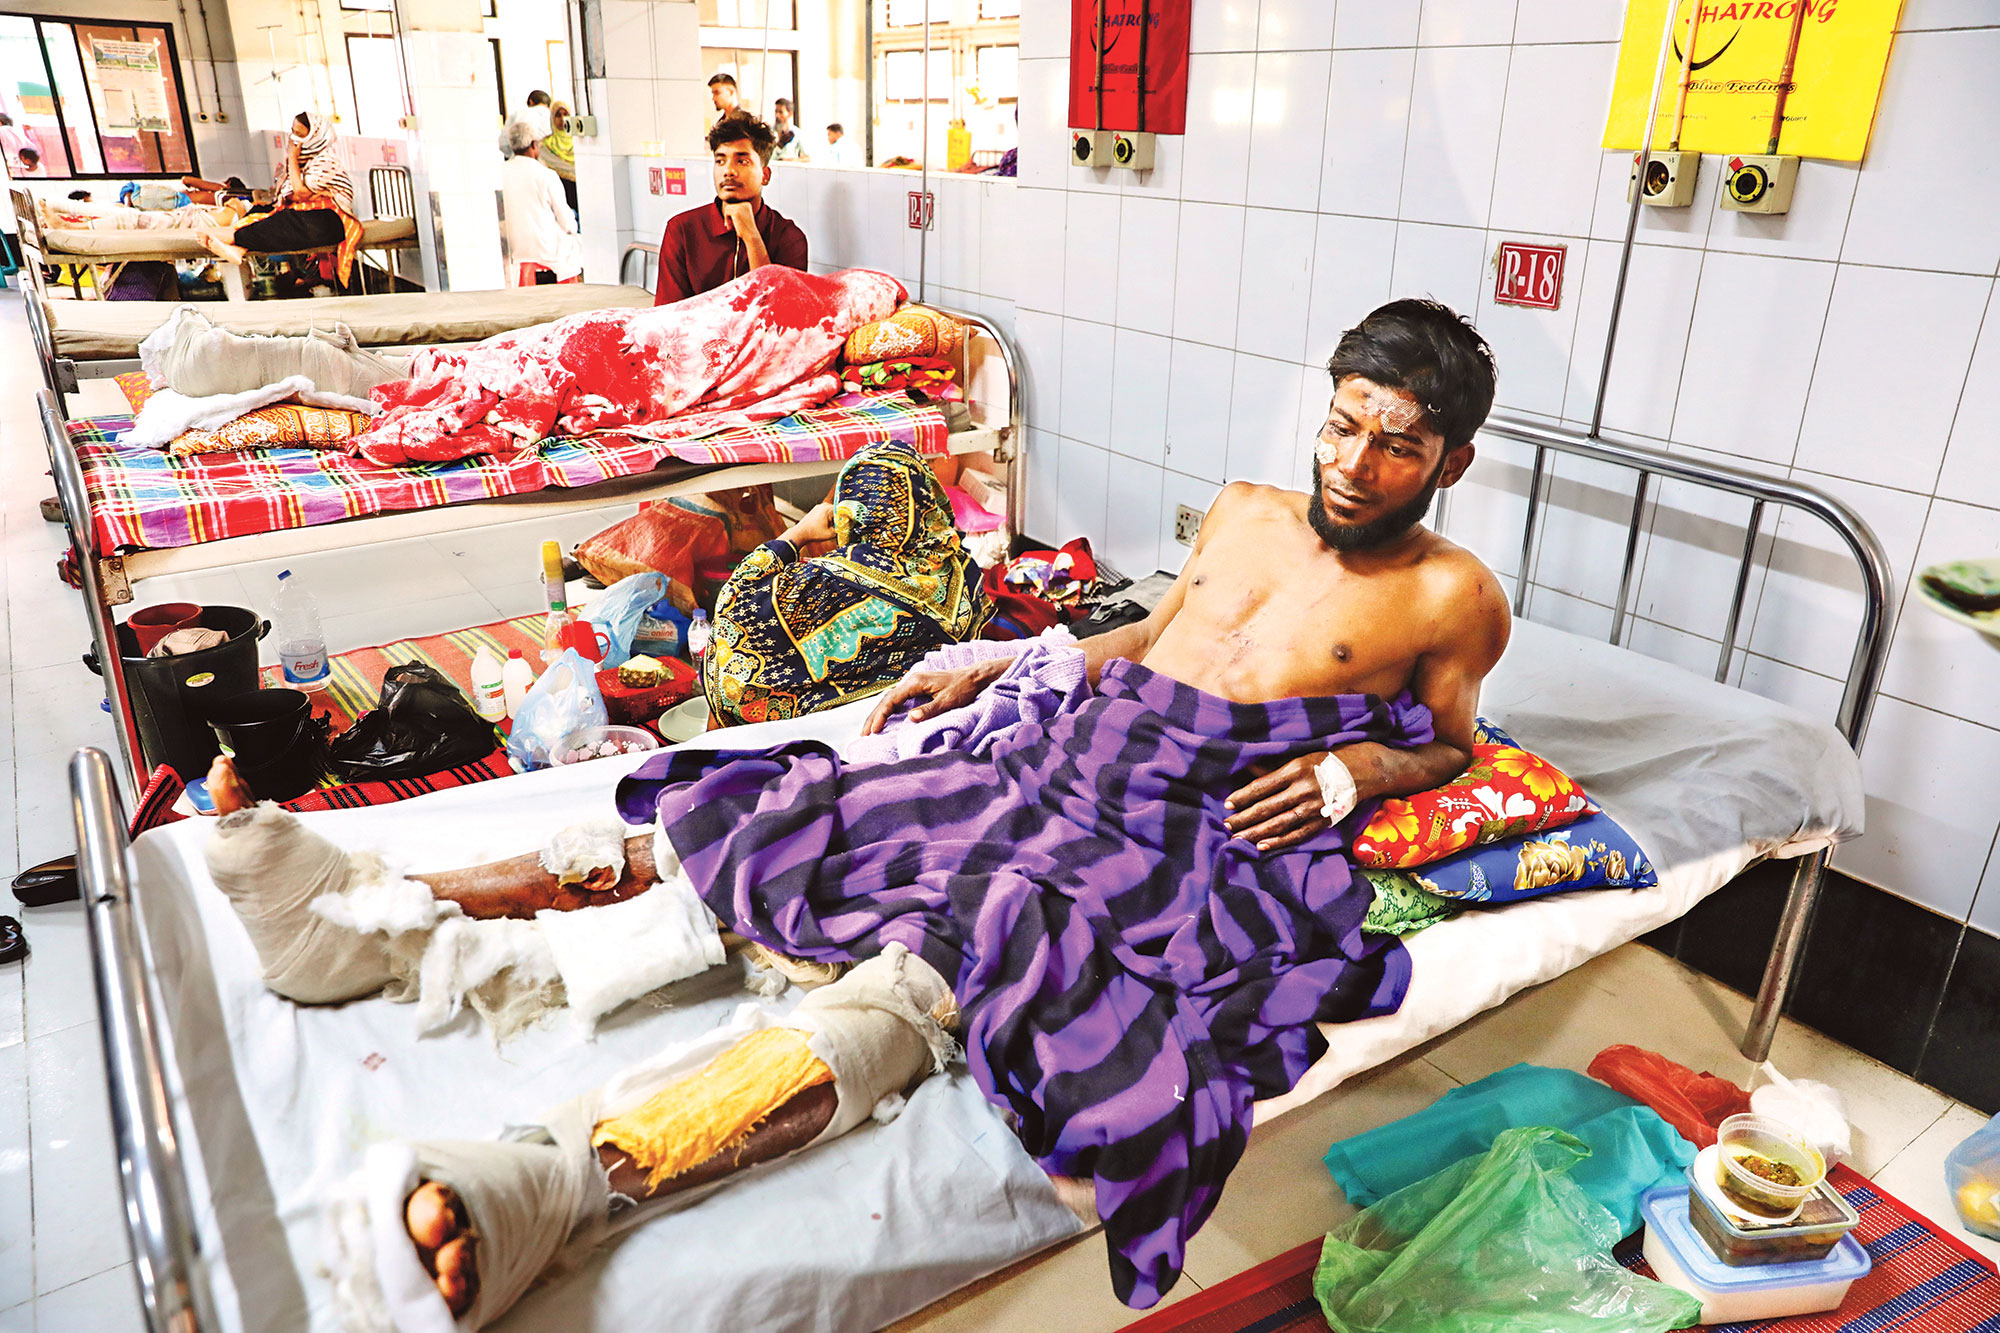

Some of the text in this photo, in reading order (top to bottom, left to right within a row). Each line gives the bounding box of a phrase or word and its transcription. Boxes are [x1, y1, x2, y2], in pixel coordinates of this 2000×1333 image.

[1685, 0, 1838, 24] HATRONG
[1688, 81, 1722, 92] Blue
[294, 659, 319, 671] Fresh
